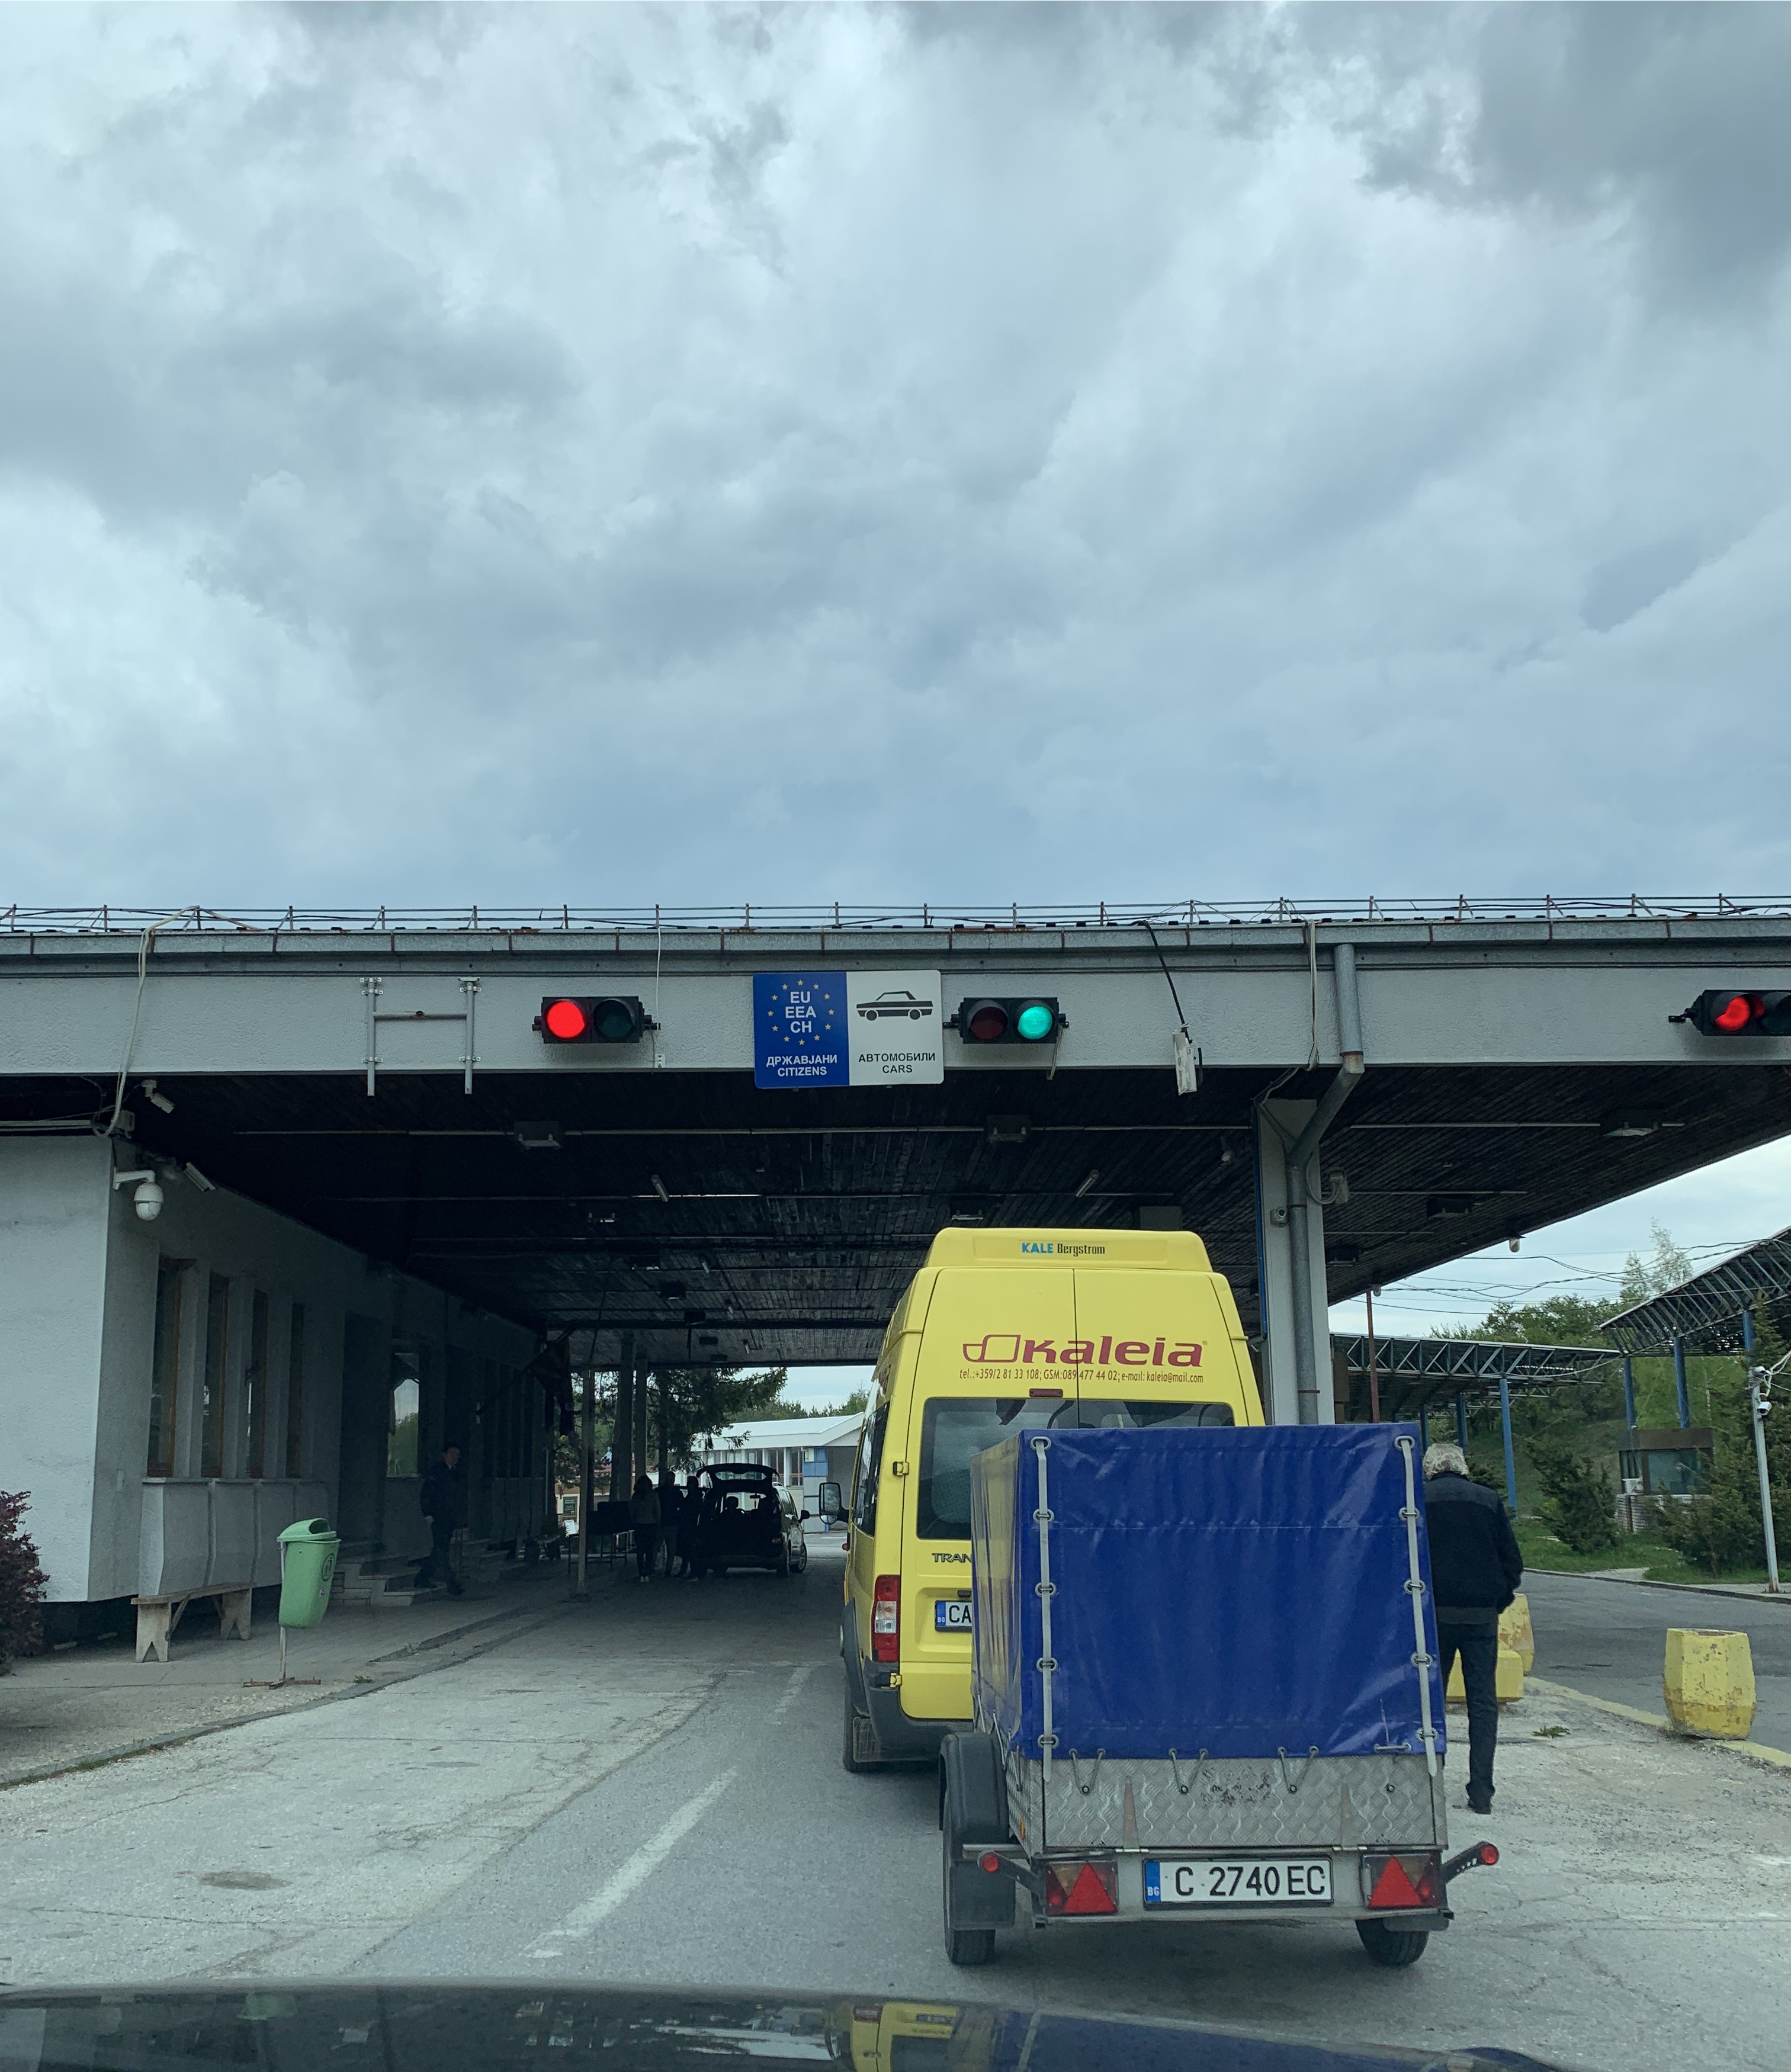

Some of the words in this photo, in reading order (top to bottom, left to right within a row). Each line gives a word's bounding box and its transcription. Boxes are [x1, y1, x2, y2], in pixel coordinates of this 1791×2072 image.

[790, 991, 811, 1004] EU
[785, 1006, 817, 1019] EEA
[790, 1020, 812, 1033] CH
[766, 1054, 837, 1068] ДРЖАВЈАНИ
[858, 1052, 936, 1062] АВТОМОБИЛИ
[777, 1066, 827, 1077] CITIZENS
[882, 1065, 913, 1074] CARS
[1022, 1242, 1054, 1254] KALE
[1057, 1243, 1105, 1257] Bergstrom
[1003, 1369, 1011, 1379] 81
[1014, 1369, 1023, 1379] 33
[1026, 1369, 1042, 1381] 108;
[1079, 1370, 1094, 1380] 477
[1096, 1370, 1106, 1380] 44
[1147, 1370, 1204, 1383] kaleia@mail.com
[1175, 1867, 1194, 1896] C
[1209, 1866, 1280, 1897] 2740
[1287, 1865, 1325, 1896] EC
[1147, 1886, 1160, 1896] BG
